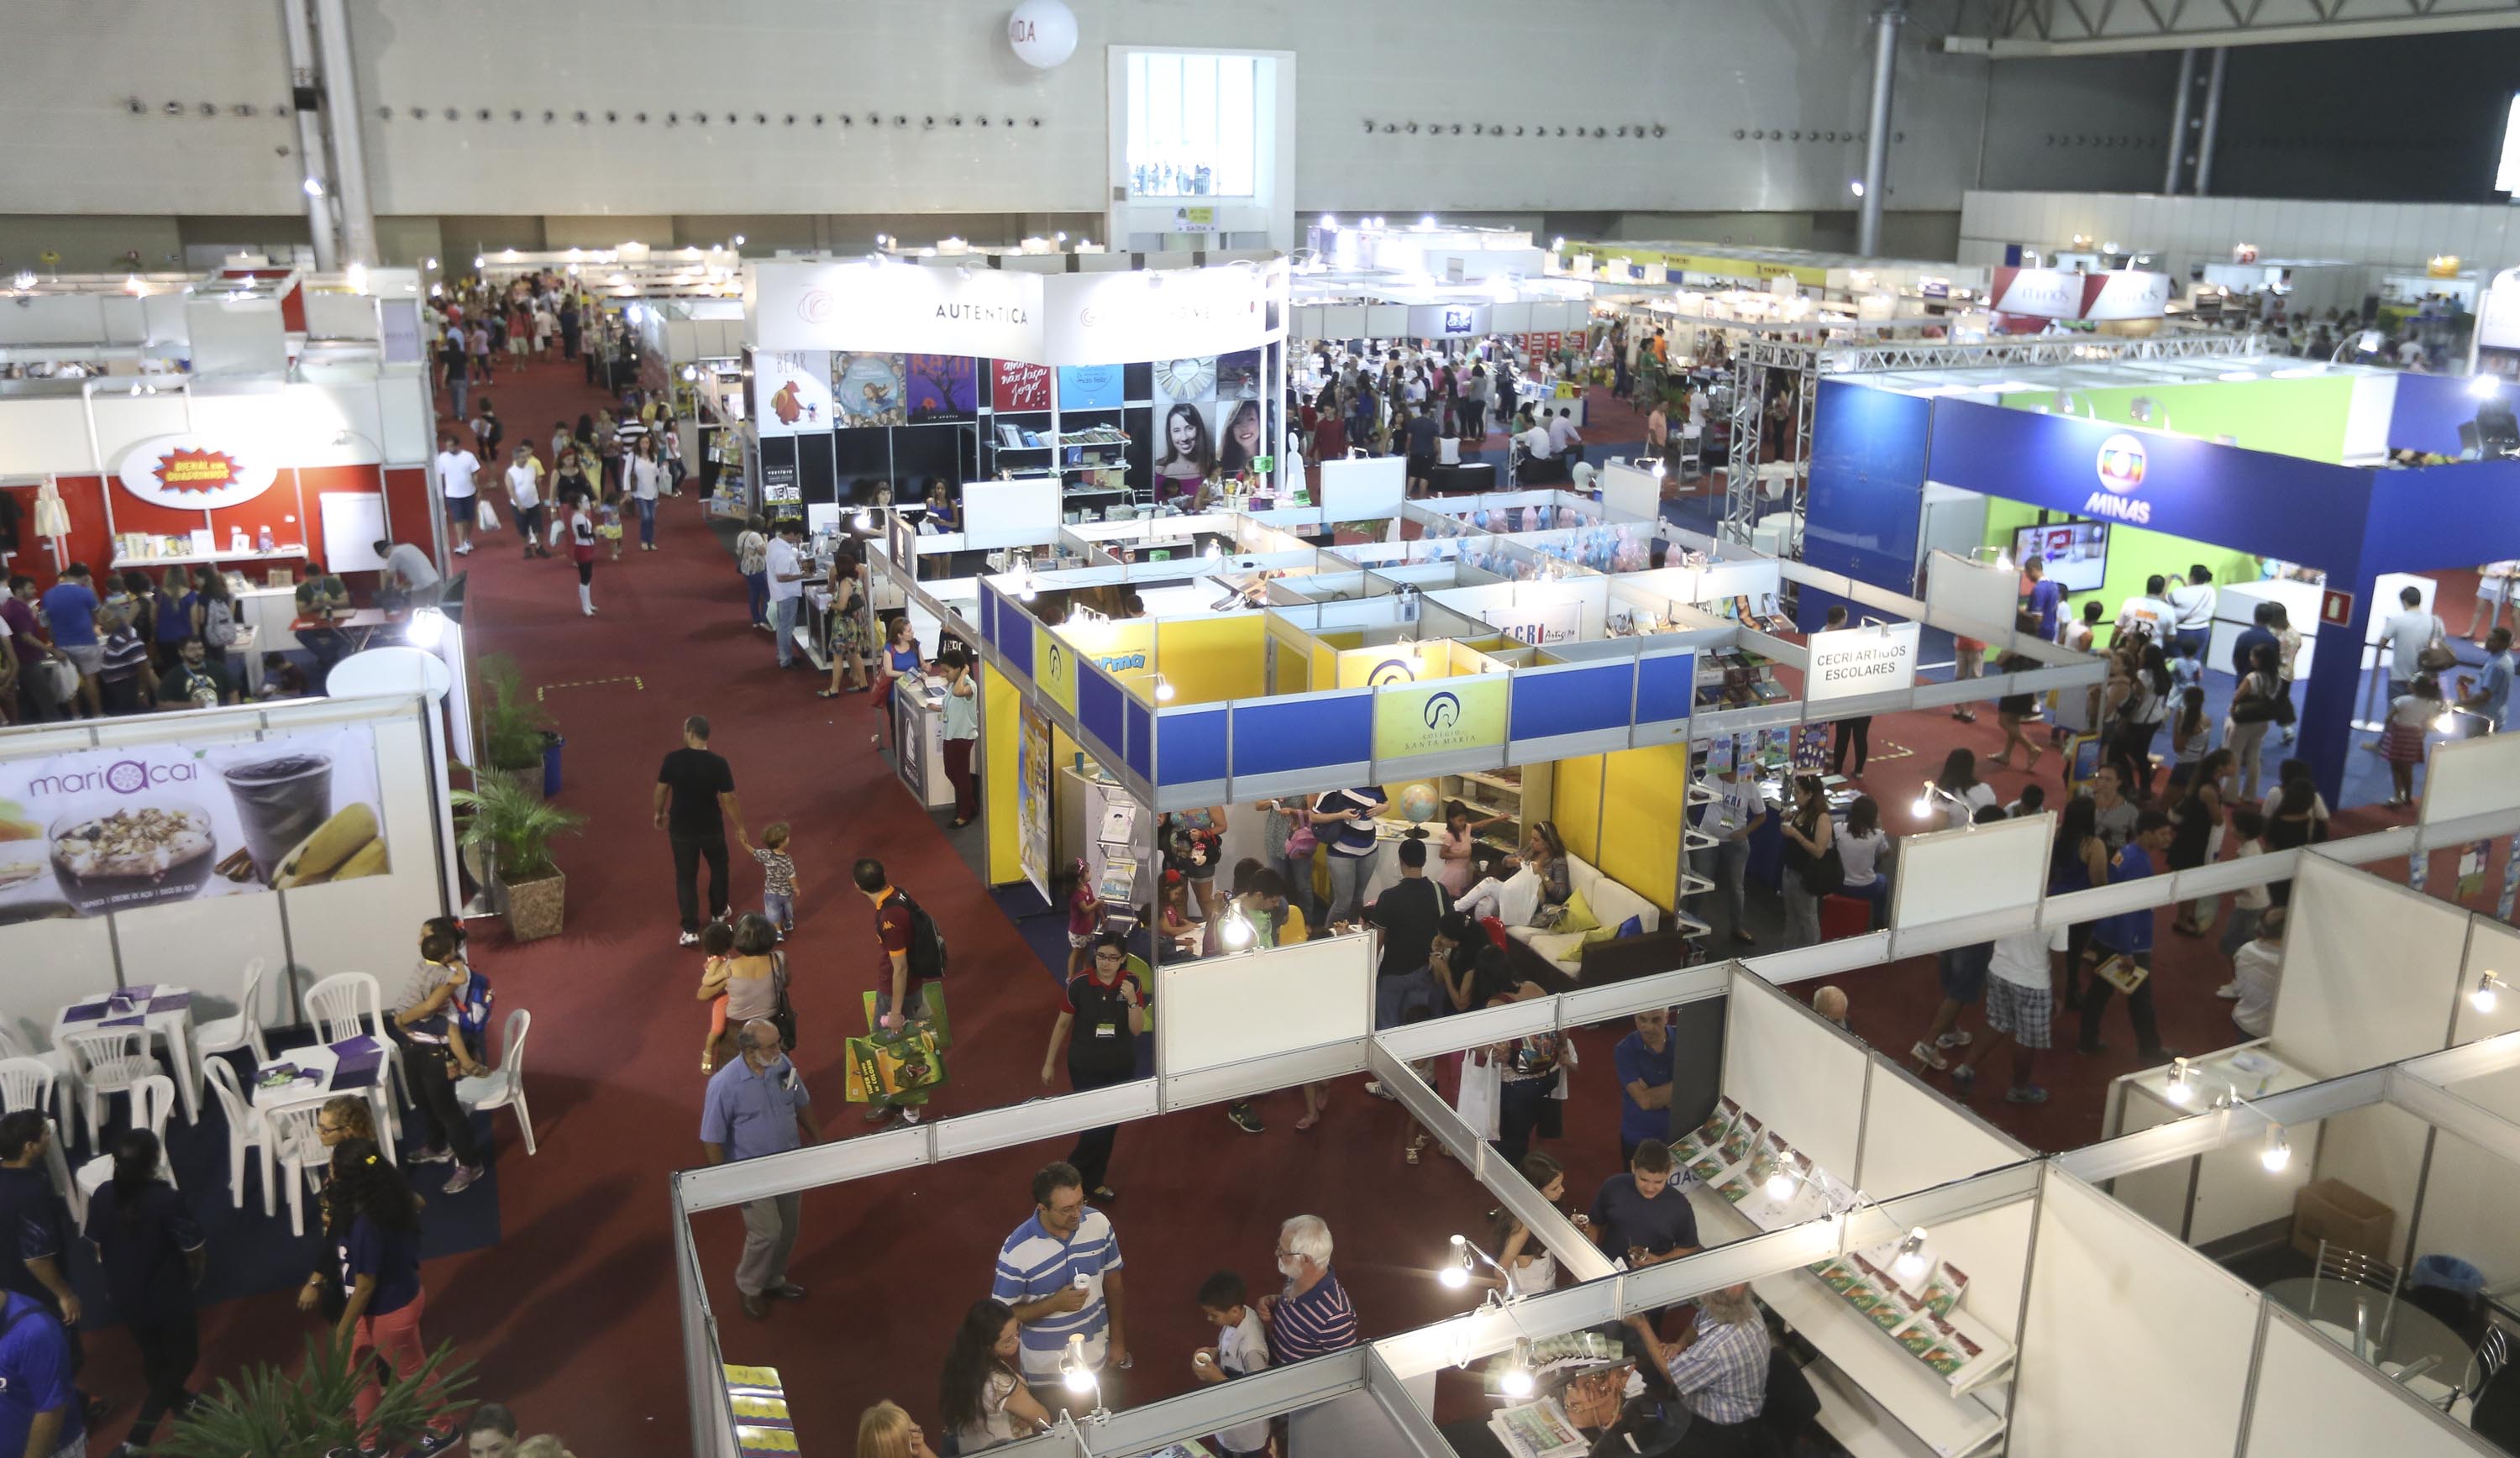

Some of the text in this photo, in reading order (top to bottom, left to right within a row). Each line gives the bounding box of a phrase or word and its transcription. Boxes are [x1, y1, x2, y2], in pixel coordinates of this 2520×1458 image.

[2083, 491, 2151, 524] MINAS
[1817, 652, 1853, 666] CECRI
[1825, 662, 1895, 681] ESCOLARES
[1404, 735, 1476, 750] SANTA MARIA
